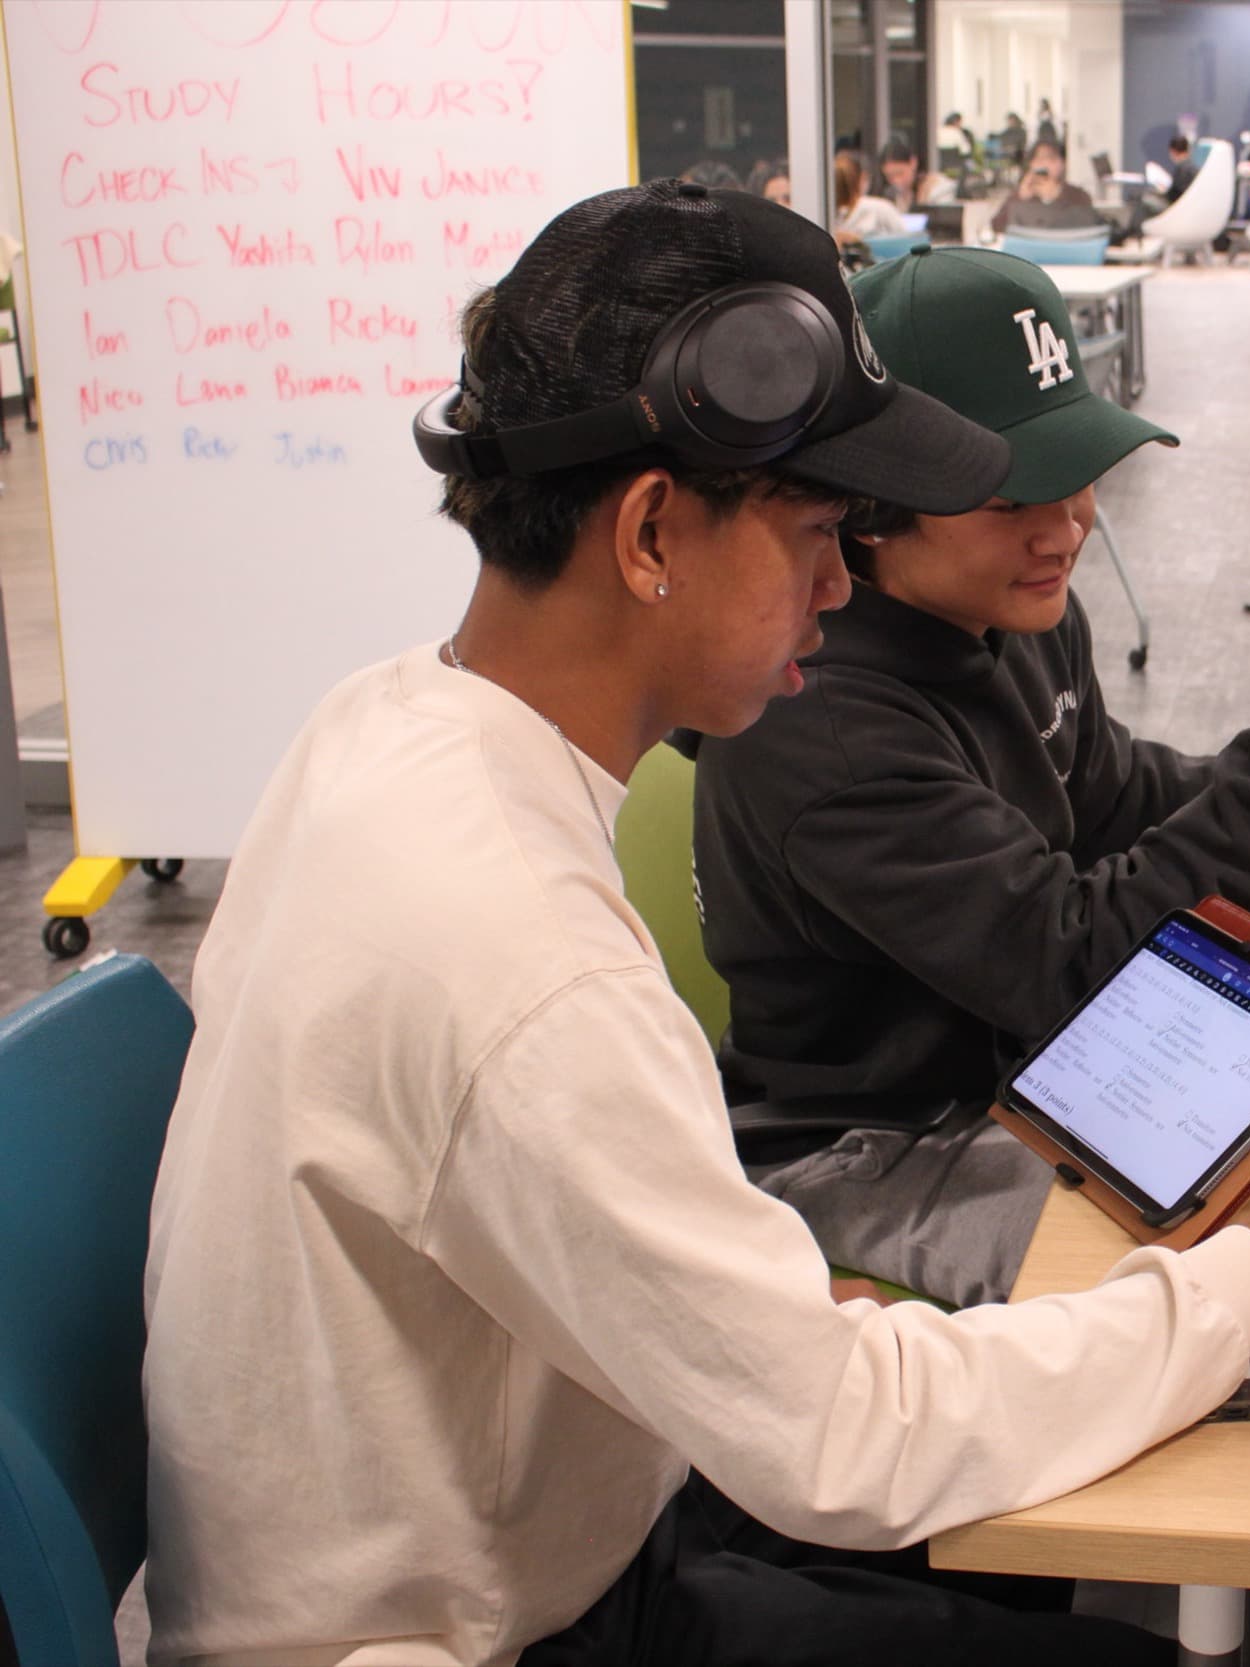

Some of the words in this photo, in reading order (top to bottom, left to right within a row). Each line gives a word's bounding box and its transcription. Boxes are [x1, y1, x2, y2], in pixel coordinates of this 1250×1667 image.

[61, 151, 188, 208] CHECK
[335, 216, 413, 276] Dylan
[1013, 308, 1074, 391] LA
